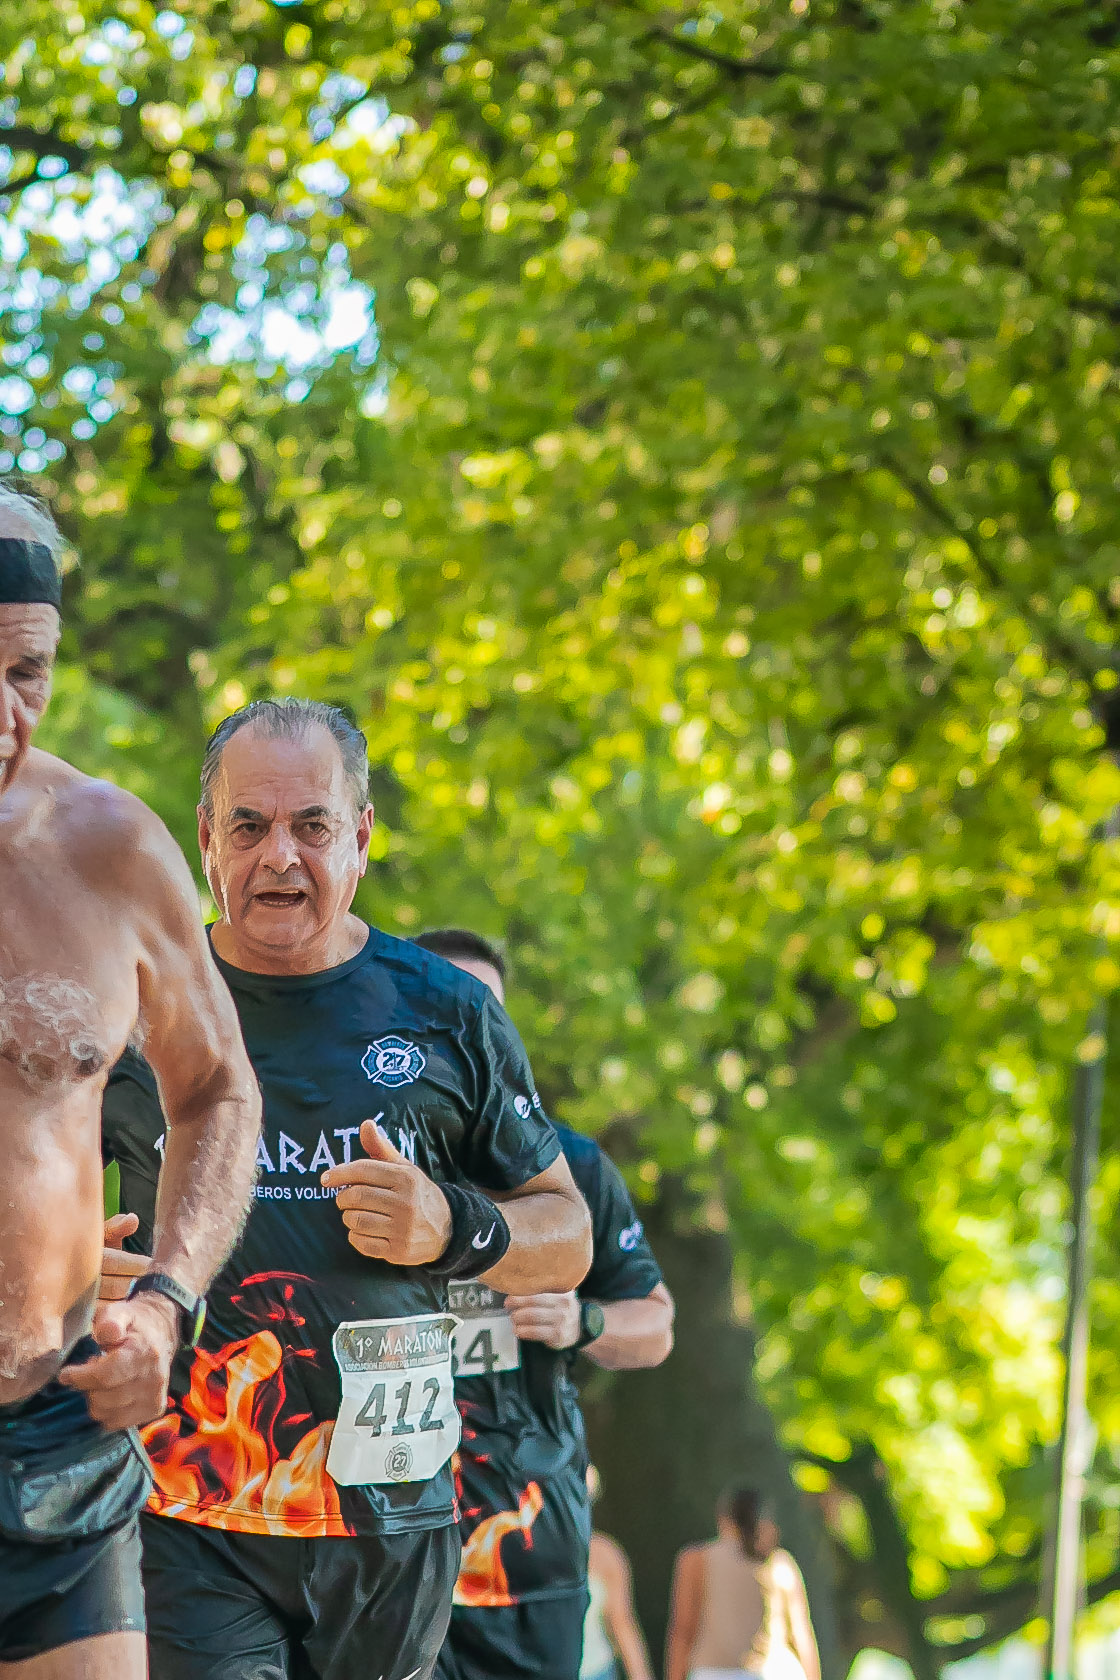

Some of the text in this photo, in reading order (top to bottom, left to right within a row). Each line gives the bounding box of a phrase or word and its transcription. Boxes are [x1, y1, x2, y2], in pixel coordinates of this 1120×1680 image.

[382, 1051, 406, 1068] 27
[250, 1186, 292, 1200] BEROS
[377, 1324, 443, 1357] MARATÓN
[353, 1377, 445, 1438] 412
